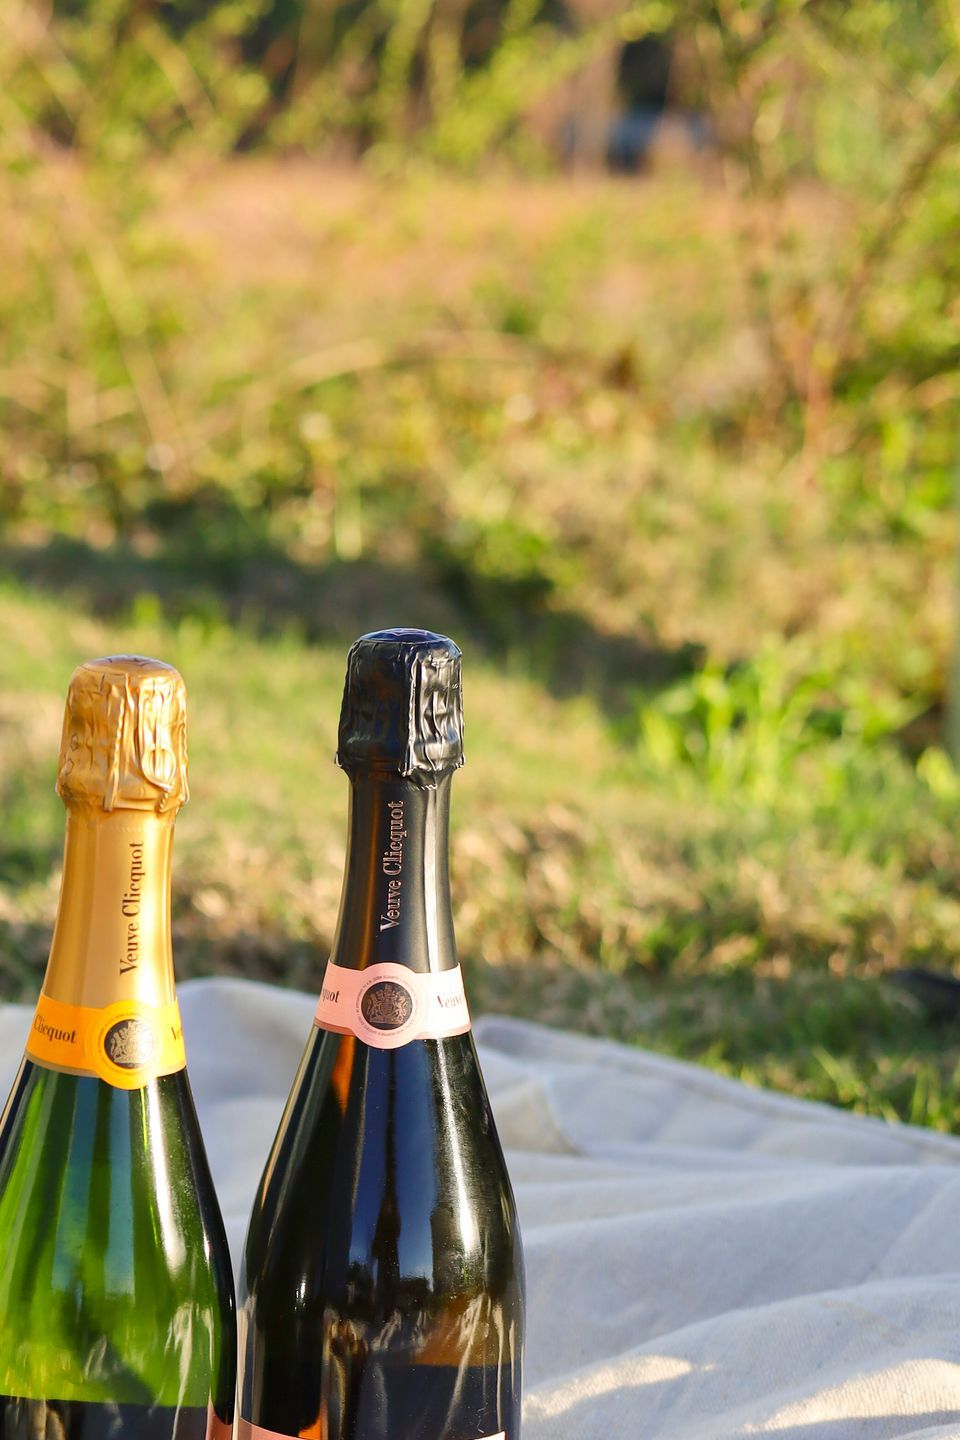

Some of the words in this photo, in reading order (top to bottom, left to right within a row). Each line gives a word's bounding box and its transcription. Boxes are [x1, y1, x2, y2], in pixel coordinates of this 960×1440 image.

[383, 800, 407, 875] Clicquot
[122, 841, 146, 917] Clicquot
[380, 880, 402, 932] Veuve
[120, 922, 140, 976] Veuve
